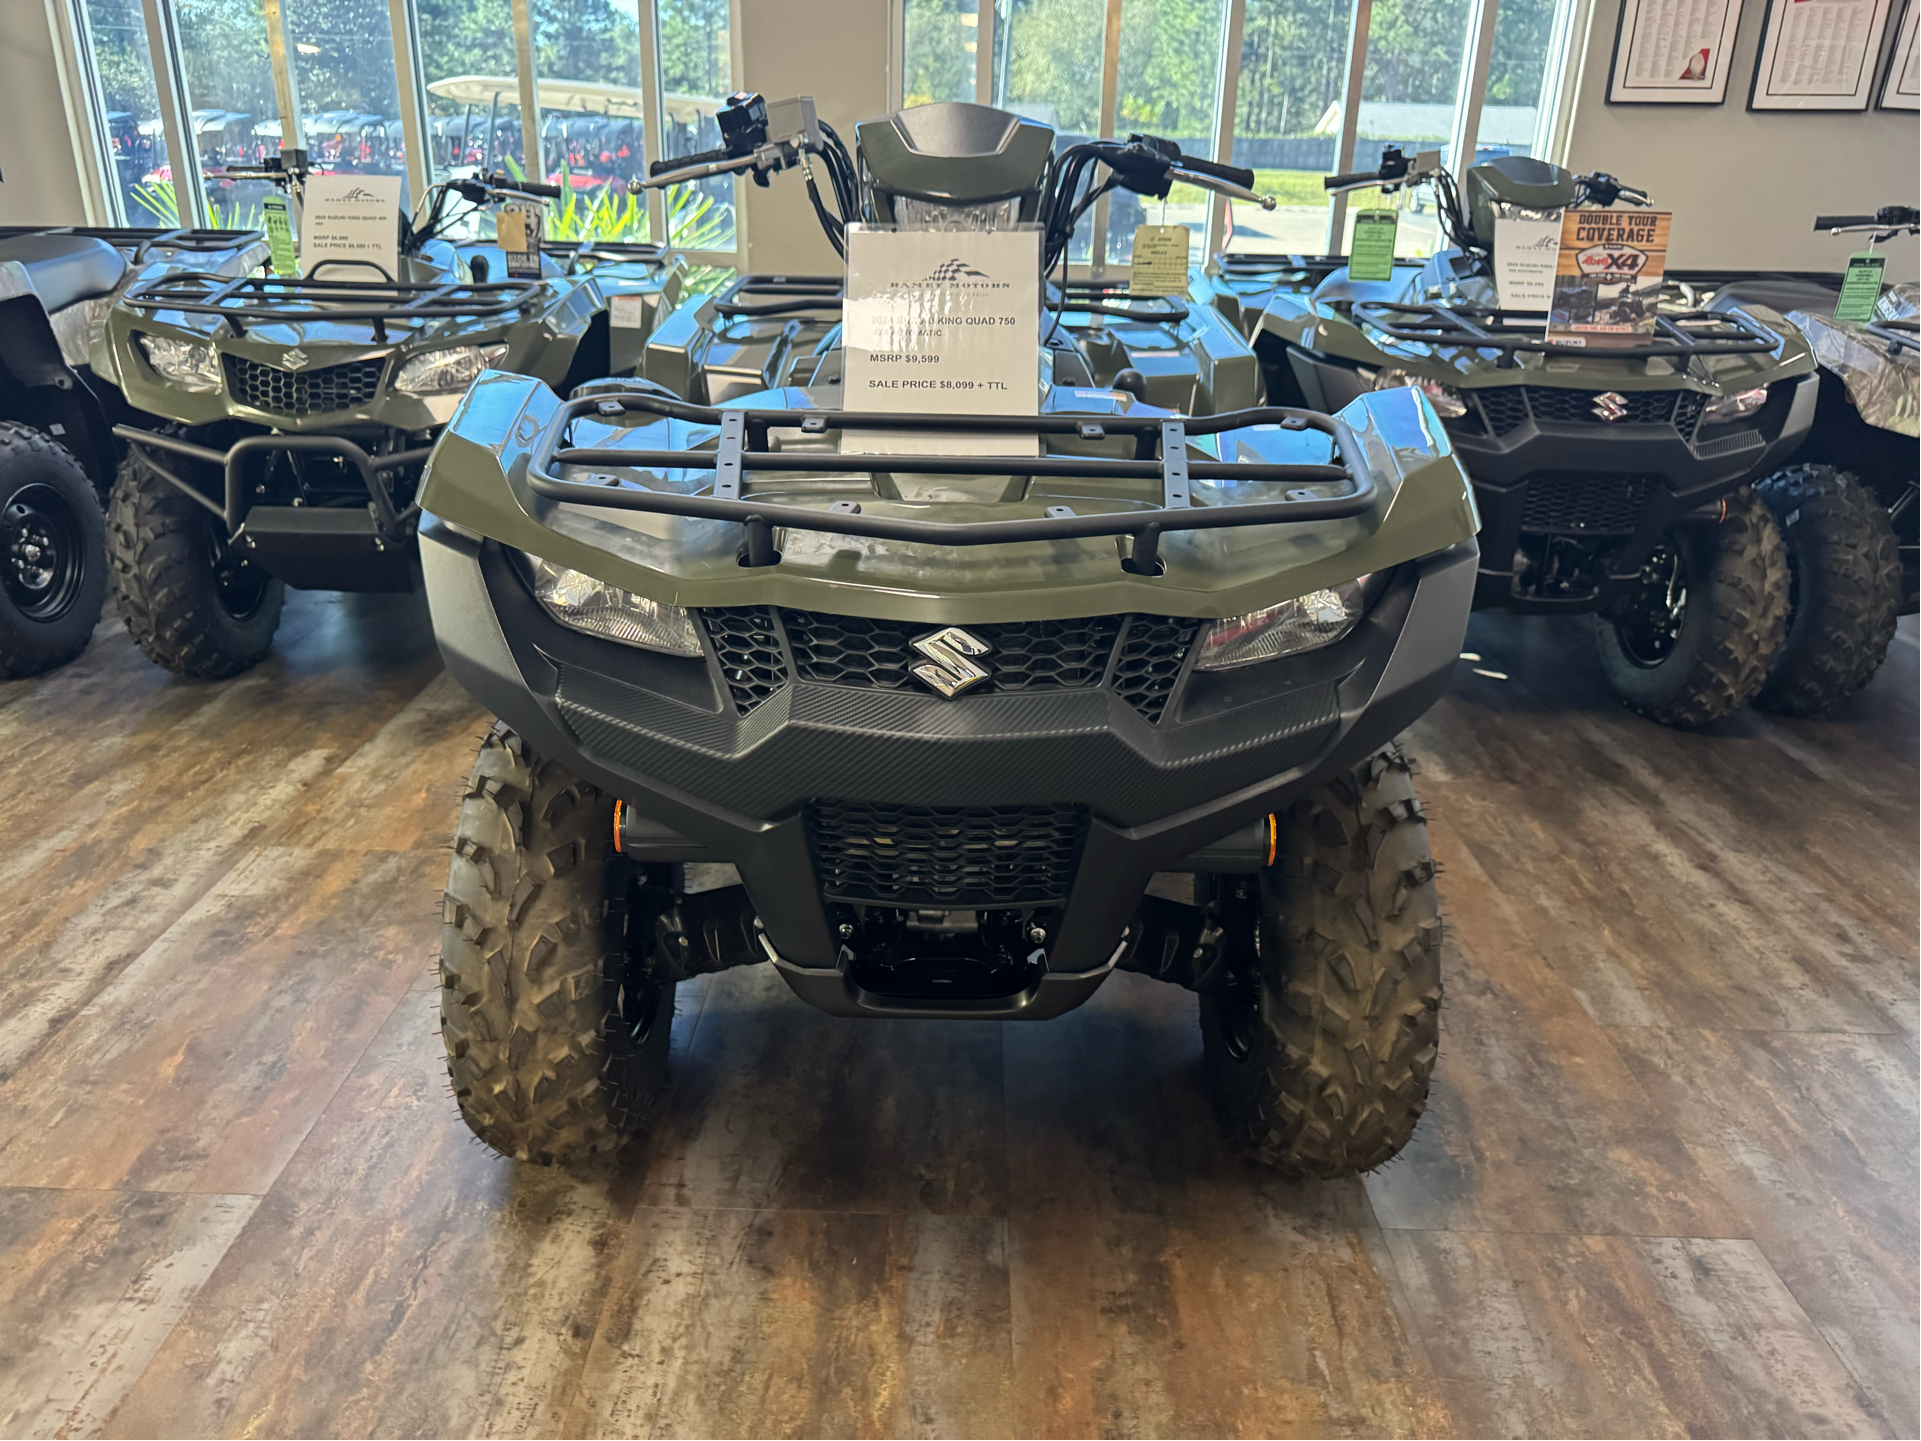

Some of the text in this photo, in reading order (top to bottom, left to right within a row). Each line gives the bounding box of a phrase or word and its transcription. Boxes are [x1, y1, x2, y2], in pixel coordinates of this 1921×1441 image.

[1578, 214, 1658, 227] DOUBLE YOUR
[1576, 227, 1656, 243] COVERAGE
[938, 317, 963, 325] KING
[965, 317, 996, 326] QUAD
[998, 317, 1016, 326] 750
[869, 354, 940, 364] MSRP $9,599
[869, 380, 899, 389] SALE
[902, 380, 937, 389] PRICE
[939, 380, 974, 390] $8,099
[987, 382, 1008, 390] TTL
